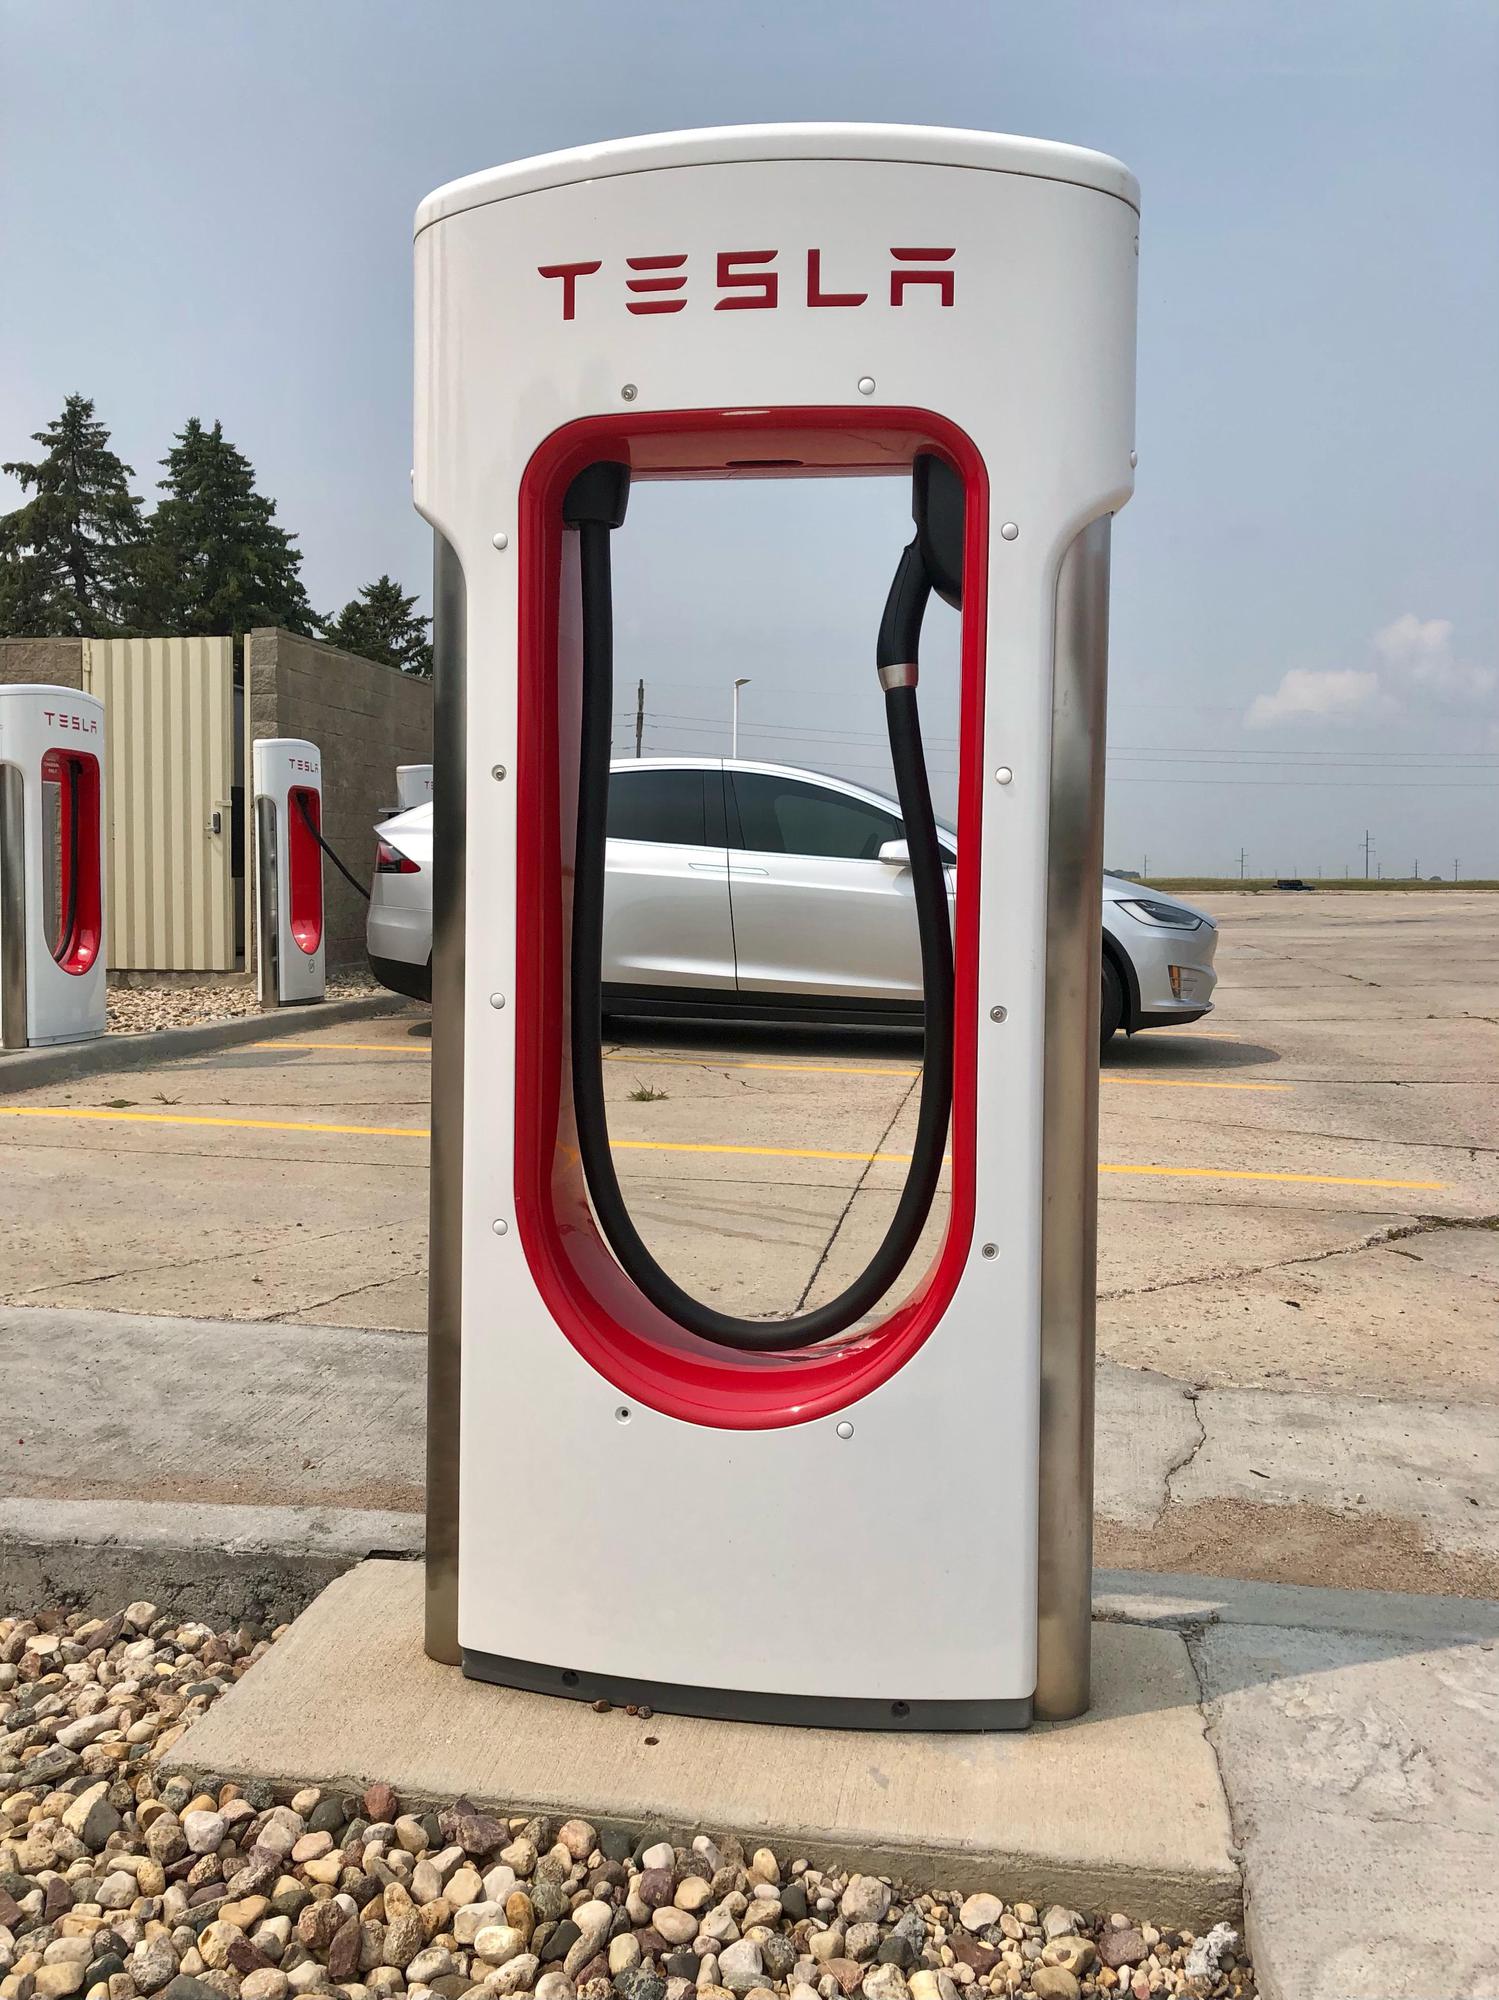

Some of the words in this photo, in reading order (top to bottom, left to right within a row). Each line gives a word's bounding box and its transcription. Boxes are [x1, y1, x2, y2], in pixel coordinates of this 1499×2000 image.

[537, 247, 957, 321] TESLA
[43, 711, 97, 734] TESLA
[288, 758, 319, 773] TESLA
